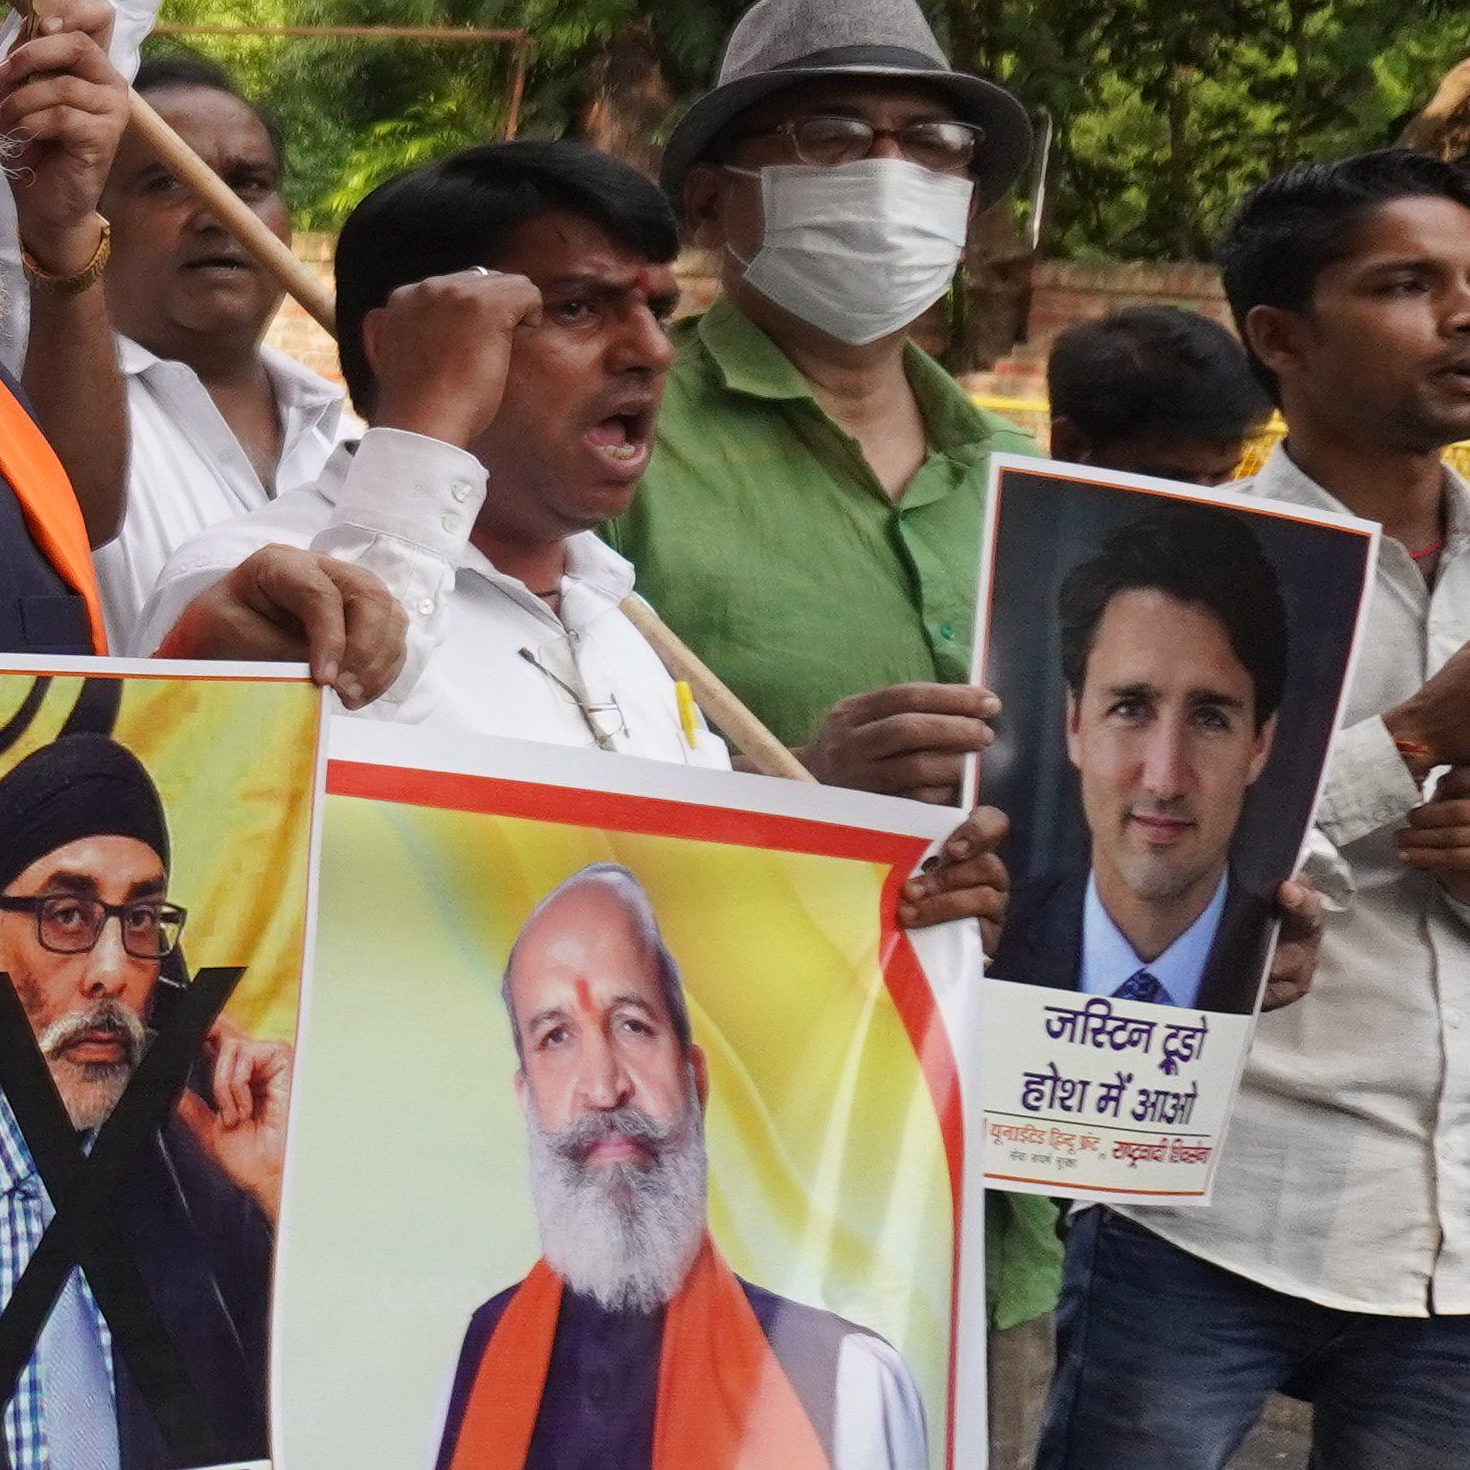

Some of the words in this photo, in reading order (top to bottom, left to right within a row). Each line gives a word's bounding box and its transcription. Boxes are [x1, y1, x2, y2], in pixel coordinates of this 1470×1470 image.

[1043, 997, 1158, 1054] जस्टिन
[1021, 1060, 1093, 1112] होश
[1095, 1070, 1136, 1118] में
[1130, 1080, 1199, 1125] आओ
